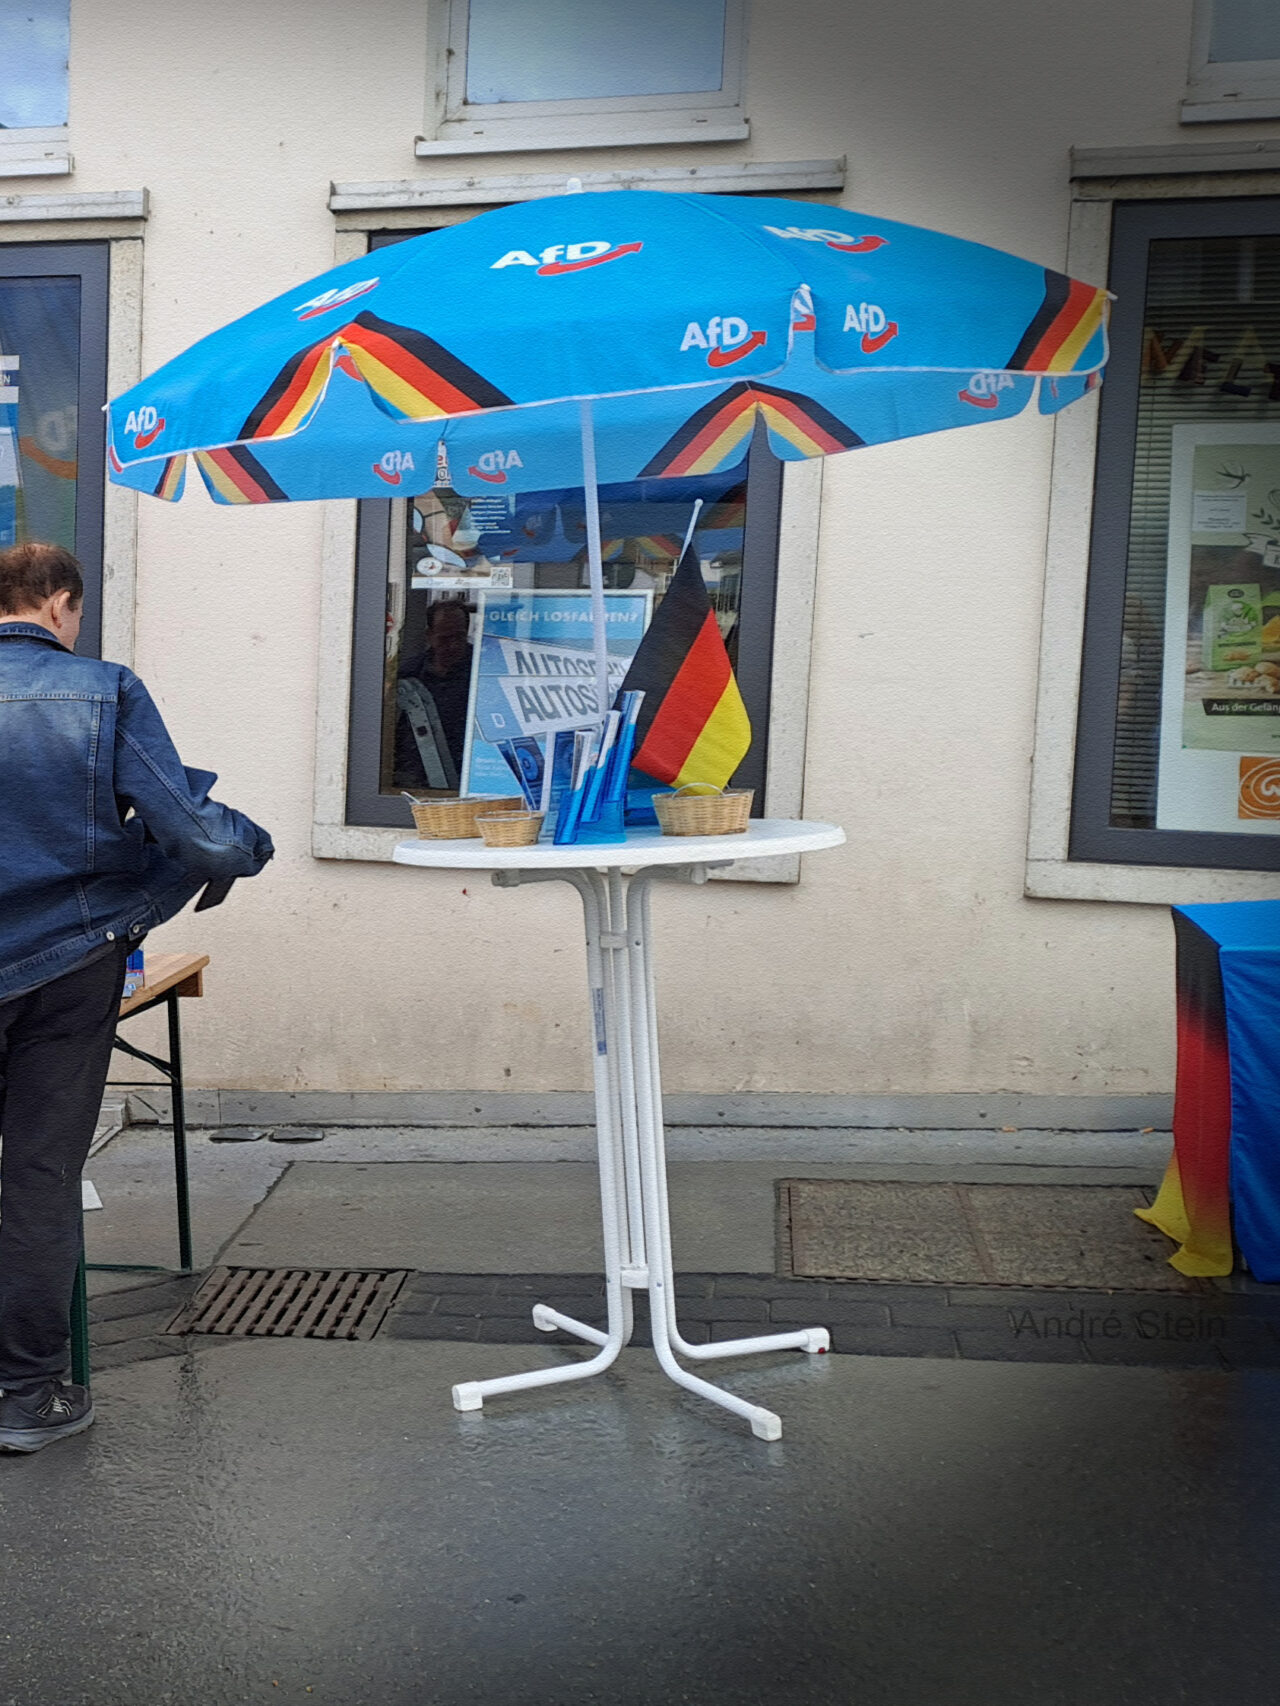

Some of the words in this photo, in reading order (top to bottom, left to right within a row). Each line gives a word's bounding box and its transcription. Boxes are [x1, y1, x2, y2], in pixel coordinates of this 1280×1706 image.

[489, 241, 612, 269] AfD
[843, 302, 886, 333] AfD
[680, 316, 749, 351] AfD
[124, 406, 157, 434] AfD
[489, 611, 538, 621] GLEICH
[1211, 702, 1230, 711] Aus
[1231, 702, 1248, 711] der
[1249, 702, 1280, 713] Gefän
